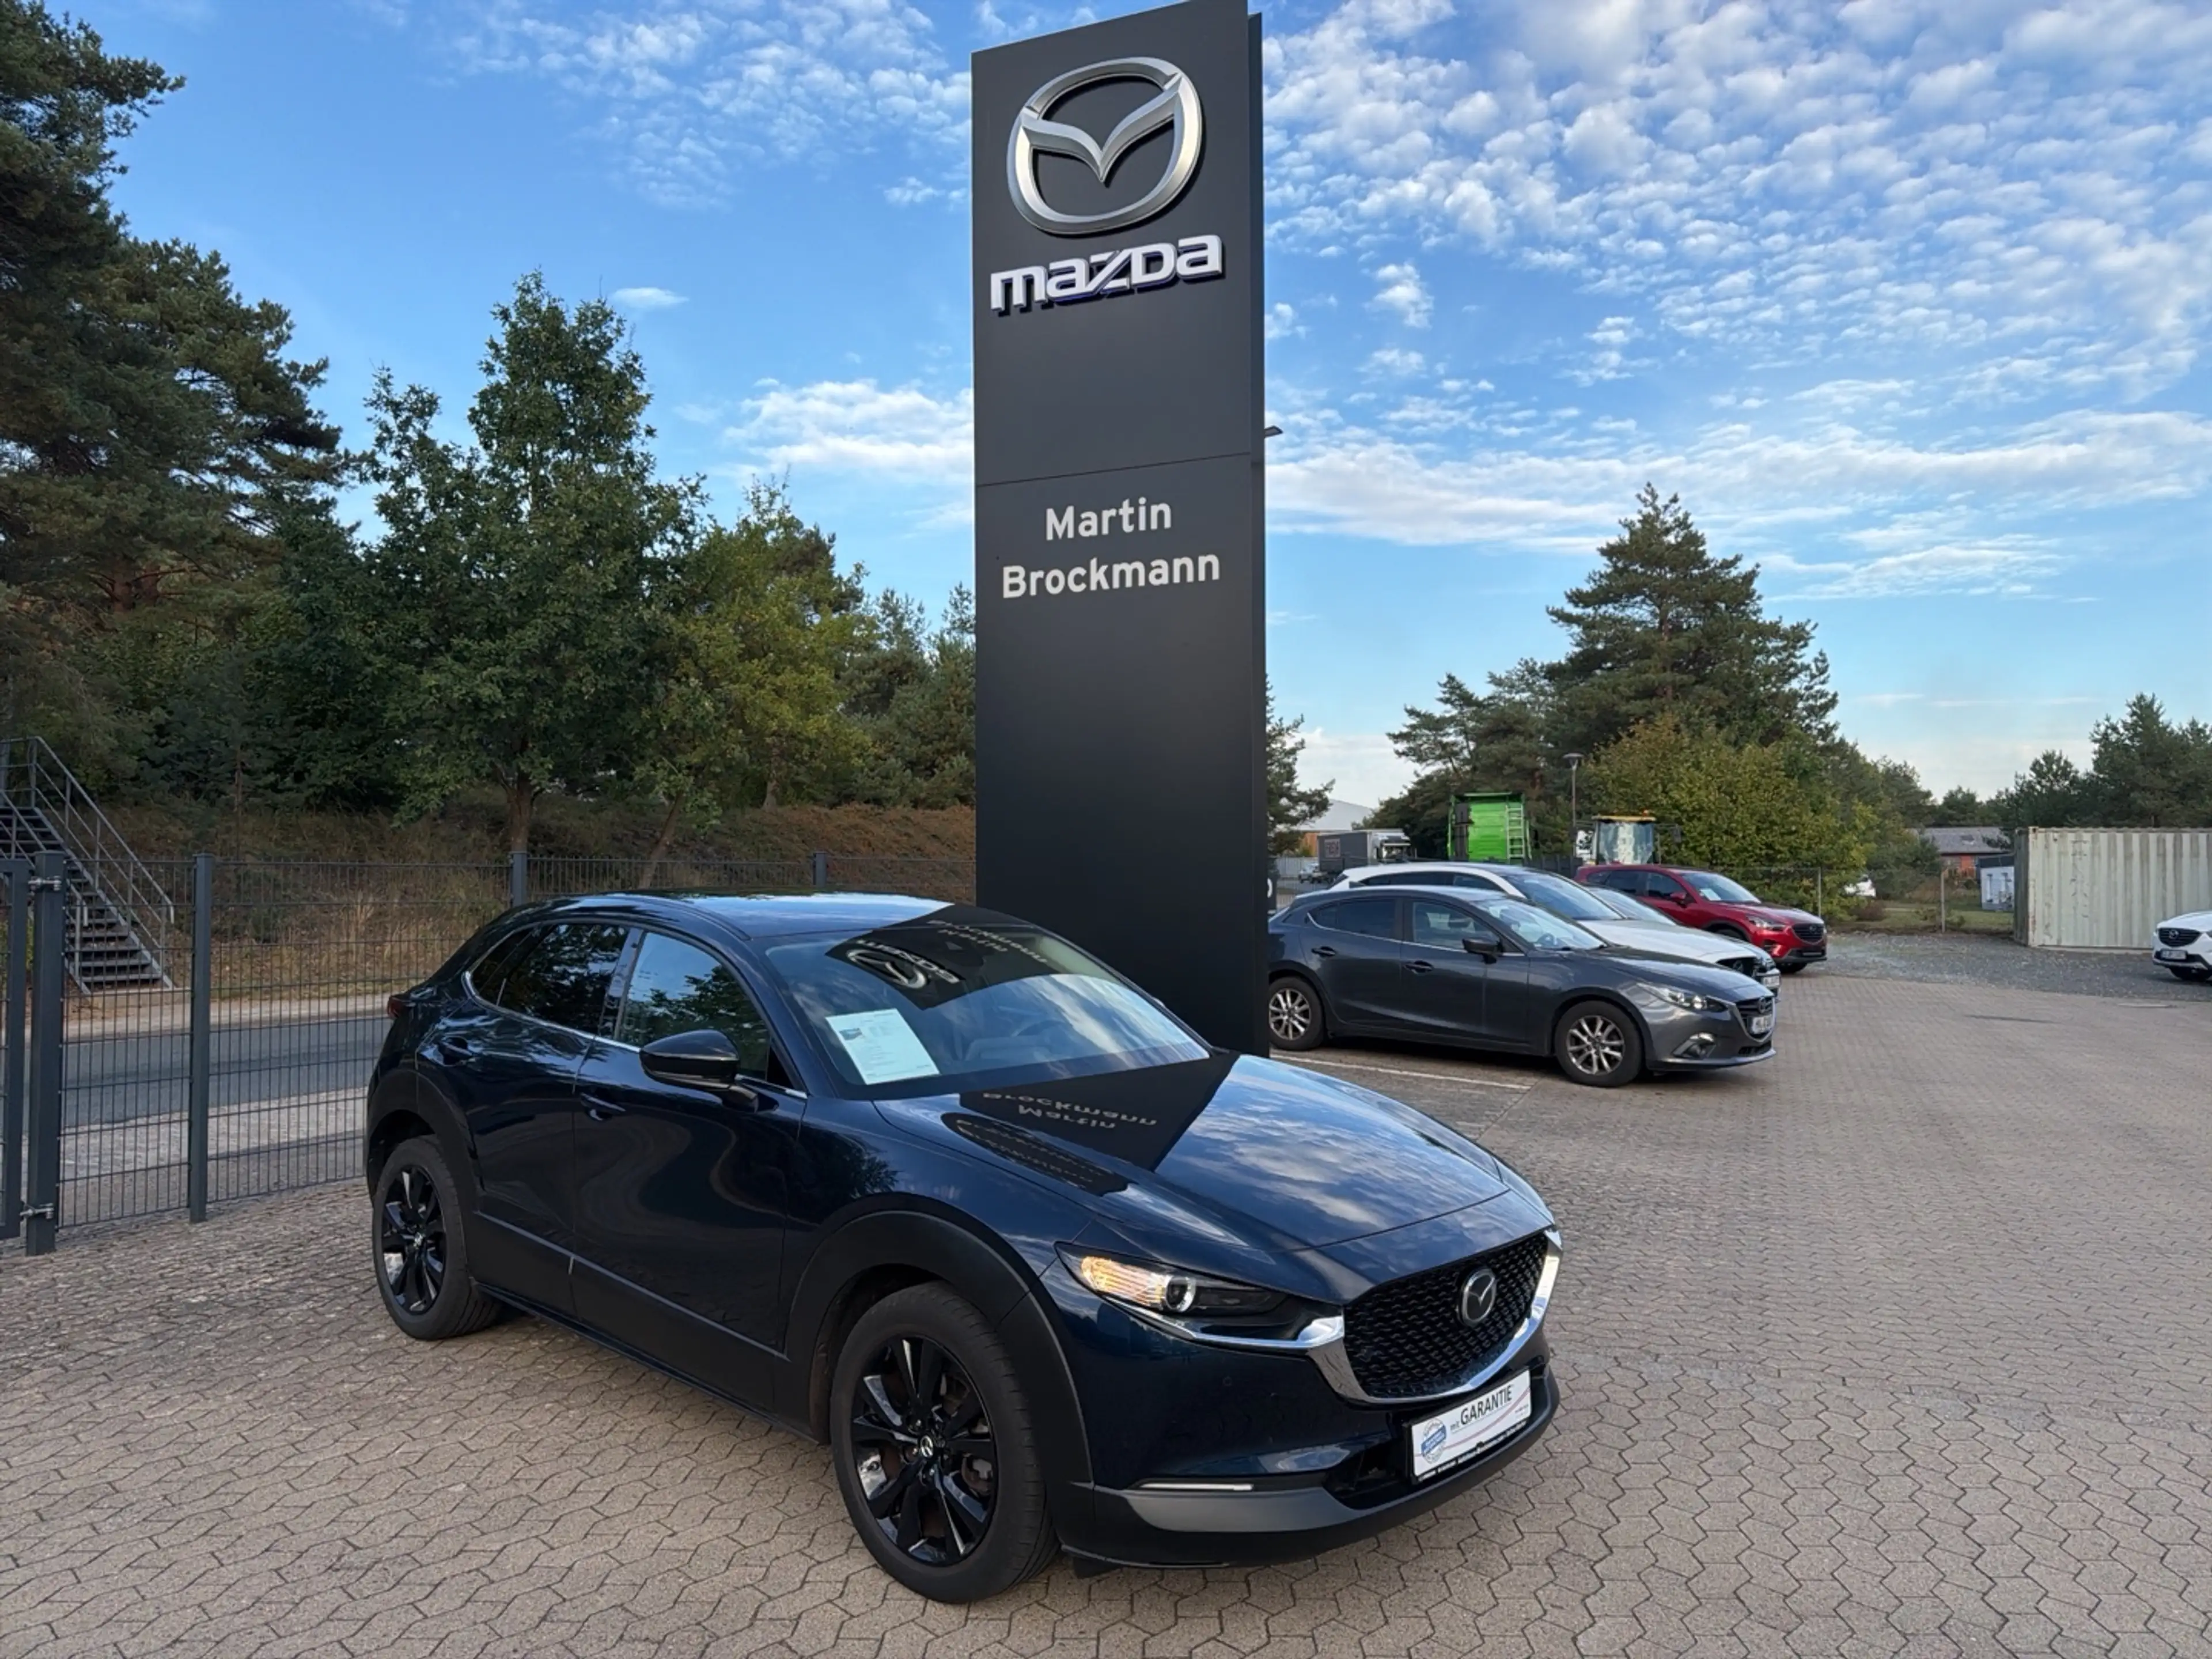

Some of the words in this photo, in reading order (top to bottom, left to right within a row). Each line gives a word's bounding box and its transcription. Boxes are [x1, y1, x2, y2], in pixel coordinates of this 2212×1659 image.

[1046, 497, 1172, 540] Martin
[1003, 554, 1219, 599] Brockmann
[1460, 1385, 1513, 1425] GARANTIE
